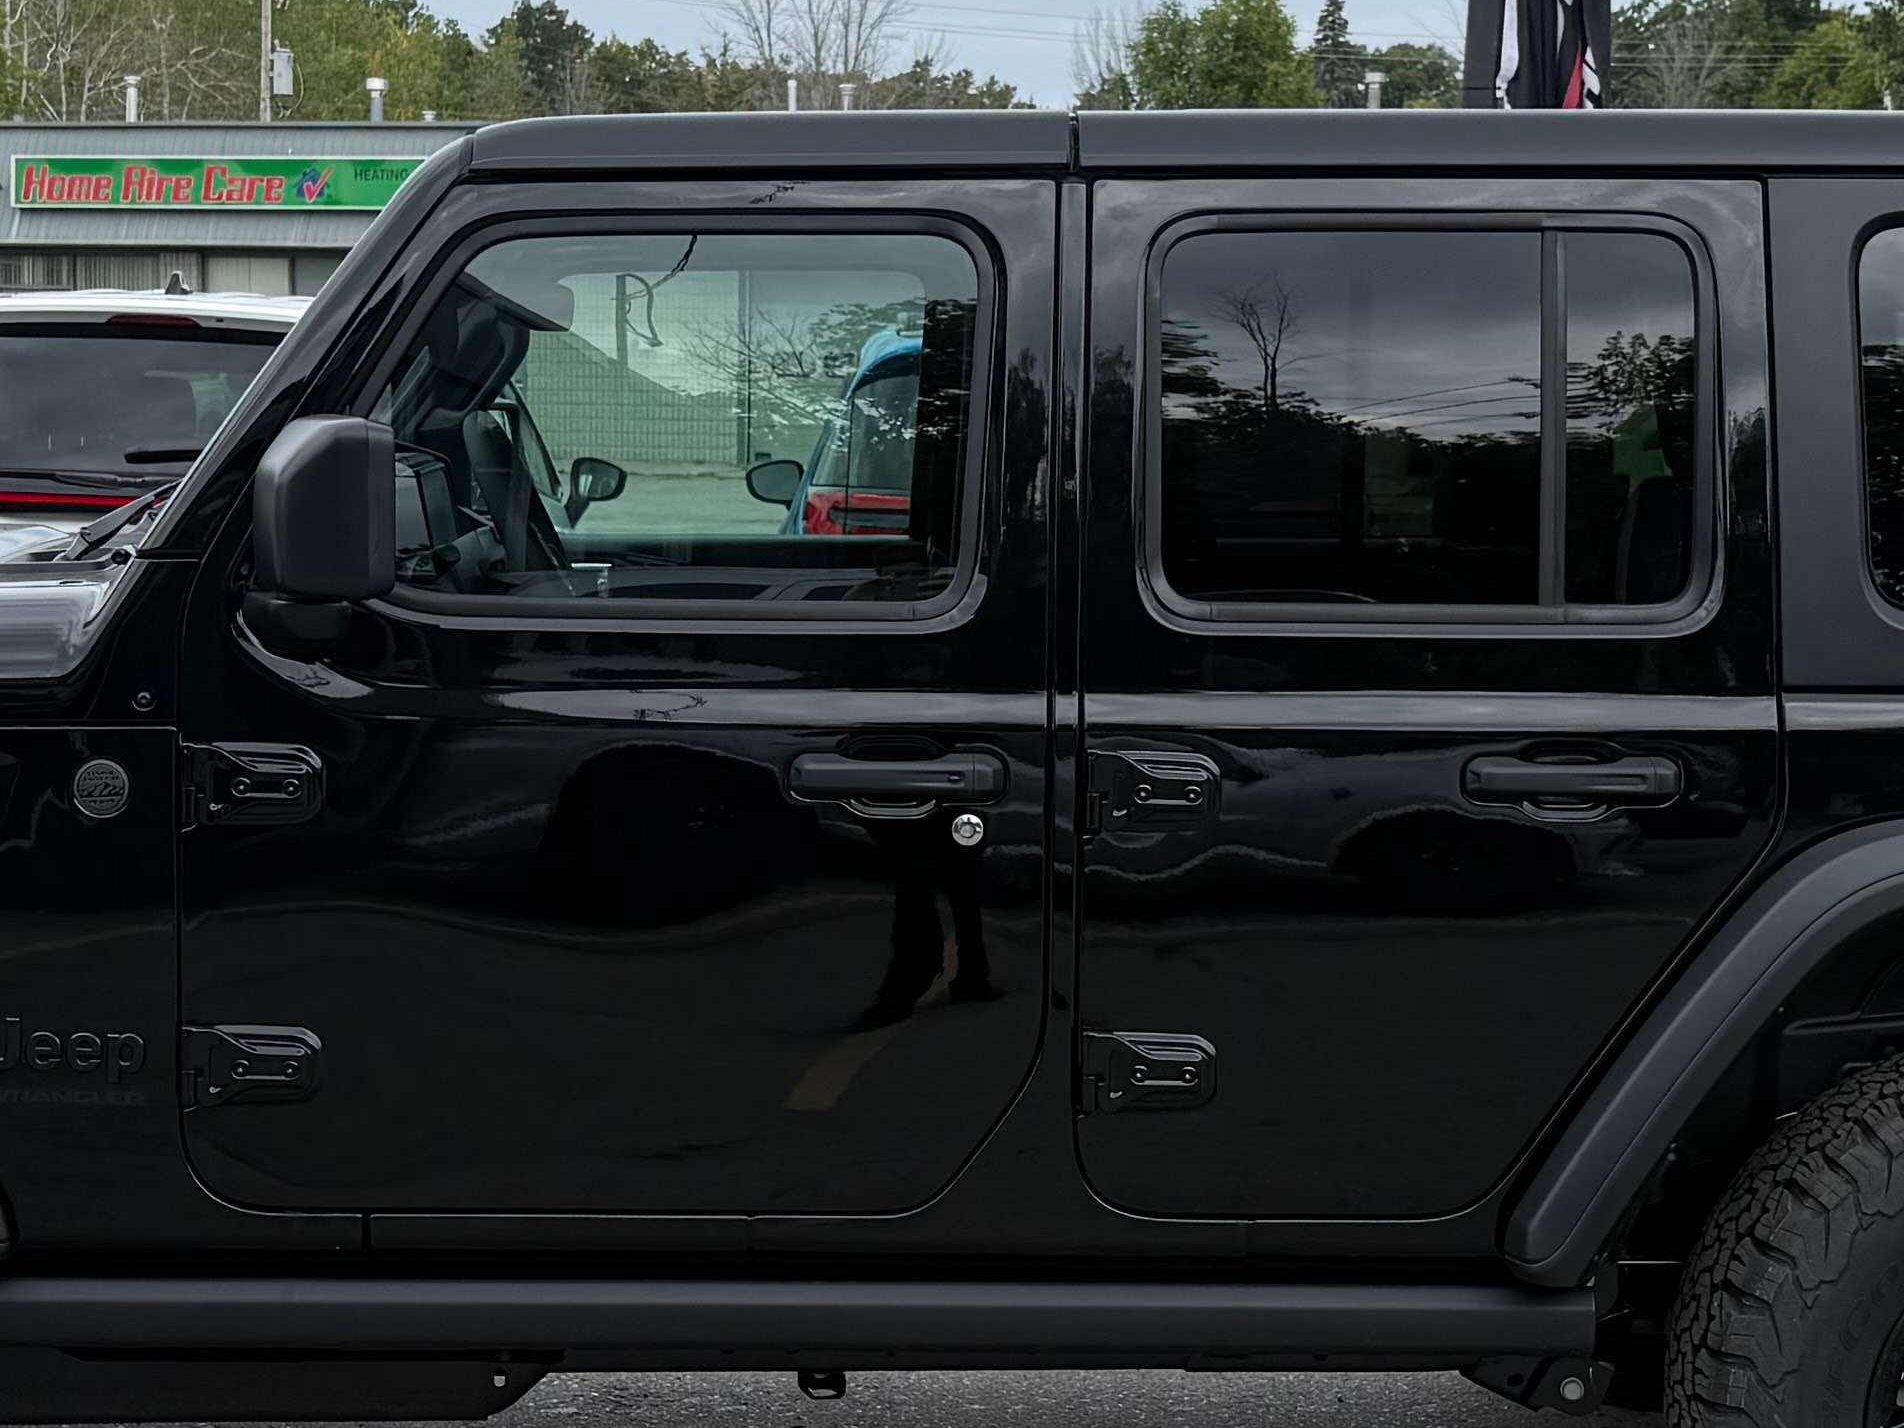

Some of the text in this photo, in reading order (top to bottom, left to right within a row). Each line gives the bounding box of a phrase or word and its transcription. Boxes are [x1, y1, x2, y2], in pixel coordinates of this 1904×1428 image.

[21, 164, 113, 204] Home
[120, 164, 193, 204] Aire
[201, 164, 286, 204] Care
